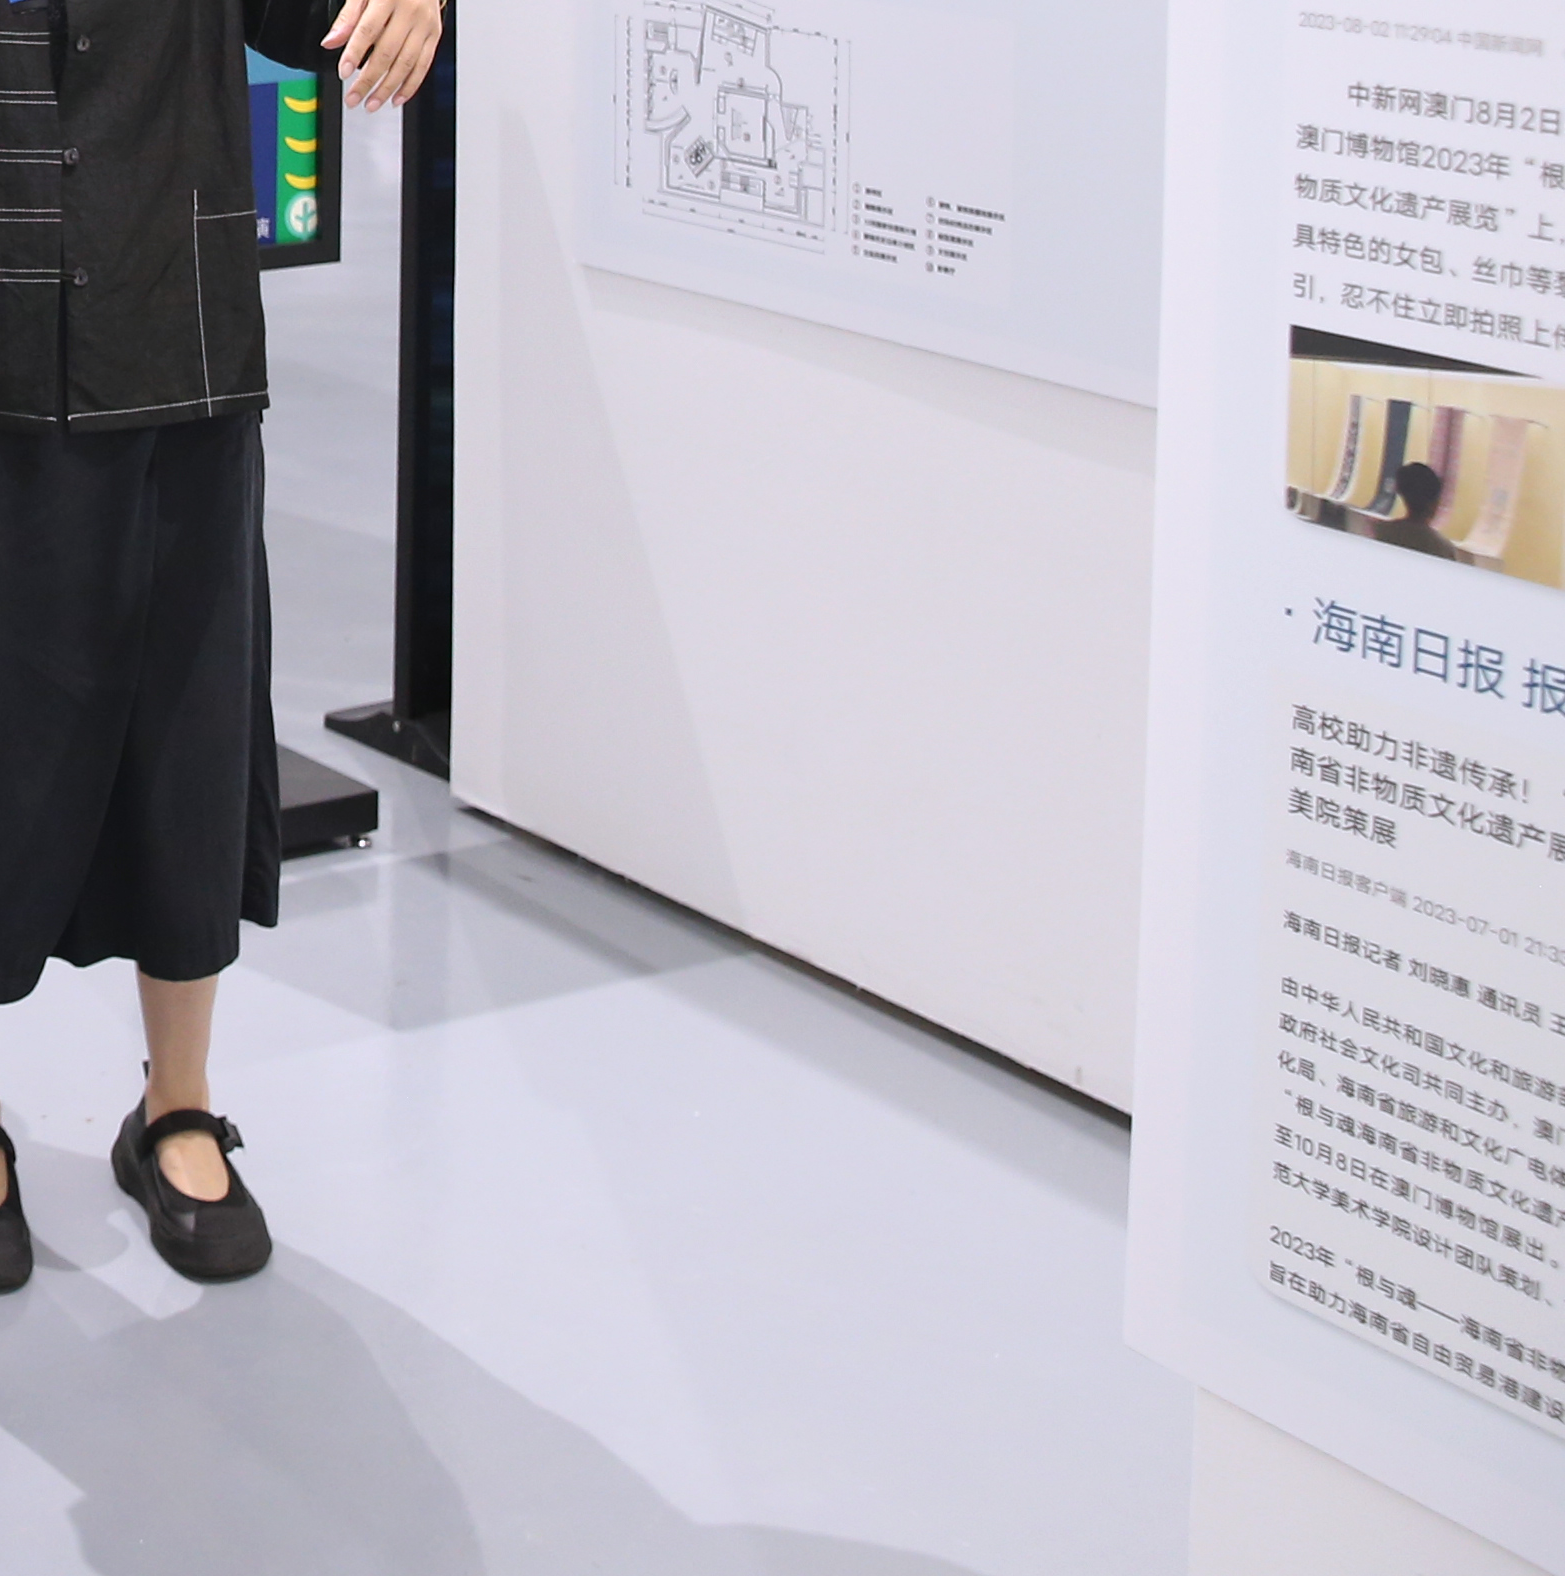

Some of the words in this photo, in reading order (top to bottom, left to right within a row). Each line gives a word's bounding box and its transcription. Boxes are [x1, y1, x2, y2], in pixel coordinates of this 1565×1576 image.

[1311, 596, 1507, 701] 海南日报
[1287, 786, 1397, 850] 美院策展
[1282, 909, 1403, 973] 海南日报记者
[1476, 983, 1543, 1027] 通讯员
